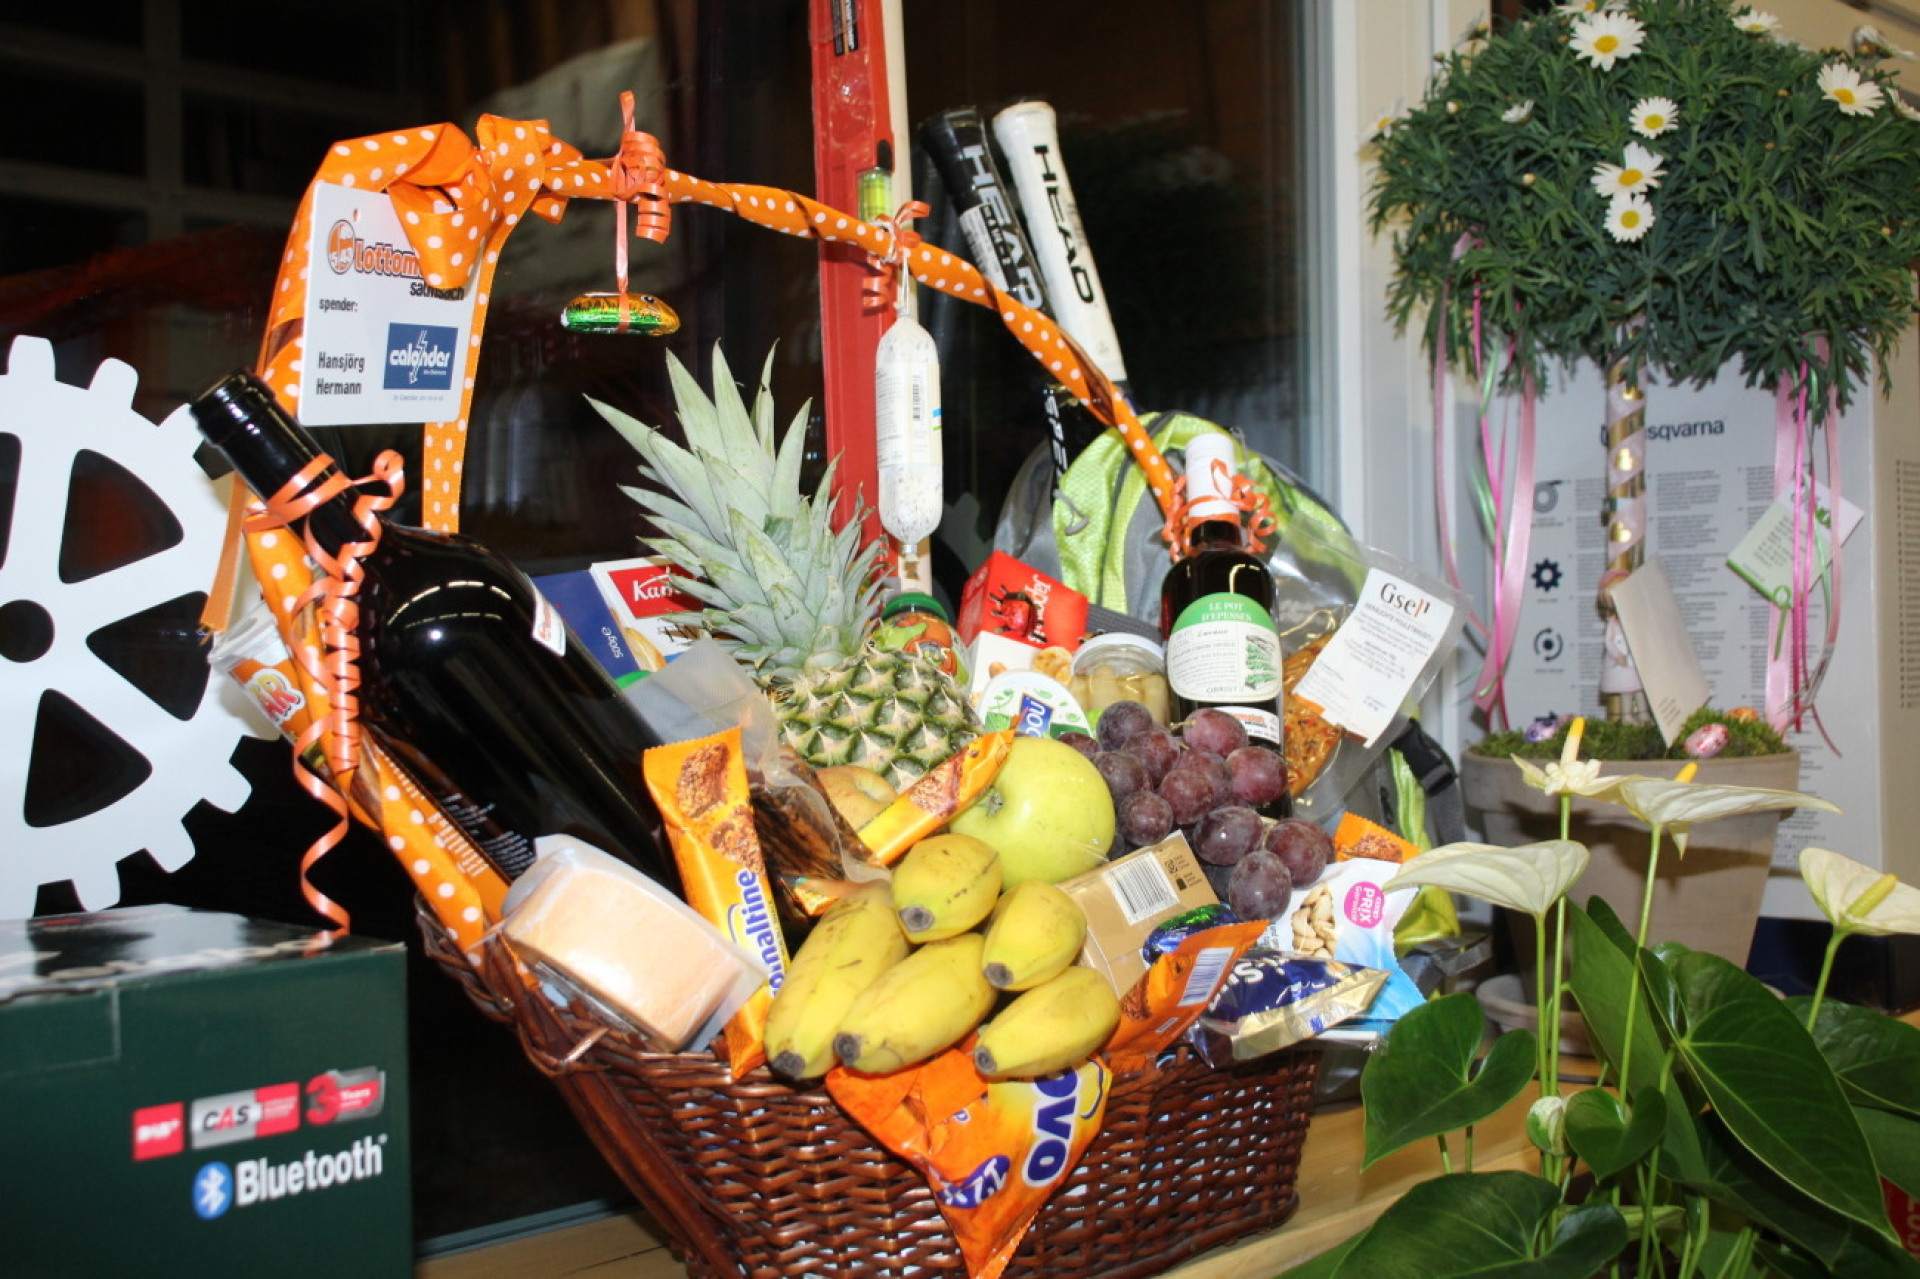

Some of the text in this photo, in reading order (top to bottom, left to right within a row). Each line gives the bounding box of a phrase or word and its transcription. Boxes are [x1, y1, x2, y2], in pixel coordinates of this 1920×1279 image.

[1033, 144, 1094, 301] HEAD
[354, 238, 423, 278] lottom
[319, 298, 358, 312] spender:
[318, 352, 366, 374] Hansjörg
[315, 378, 362, 396] Hermann
[1645, 419, 1725, 443] sqvarna
[203, 1104, 250, 1131] CAS
